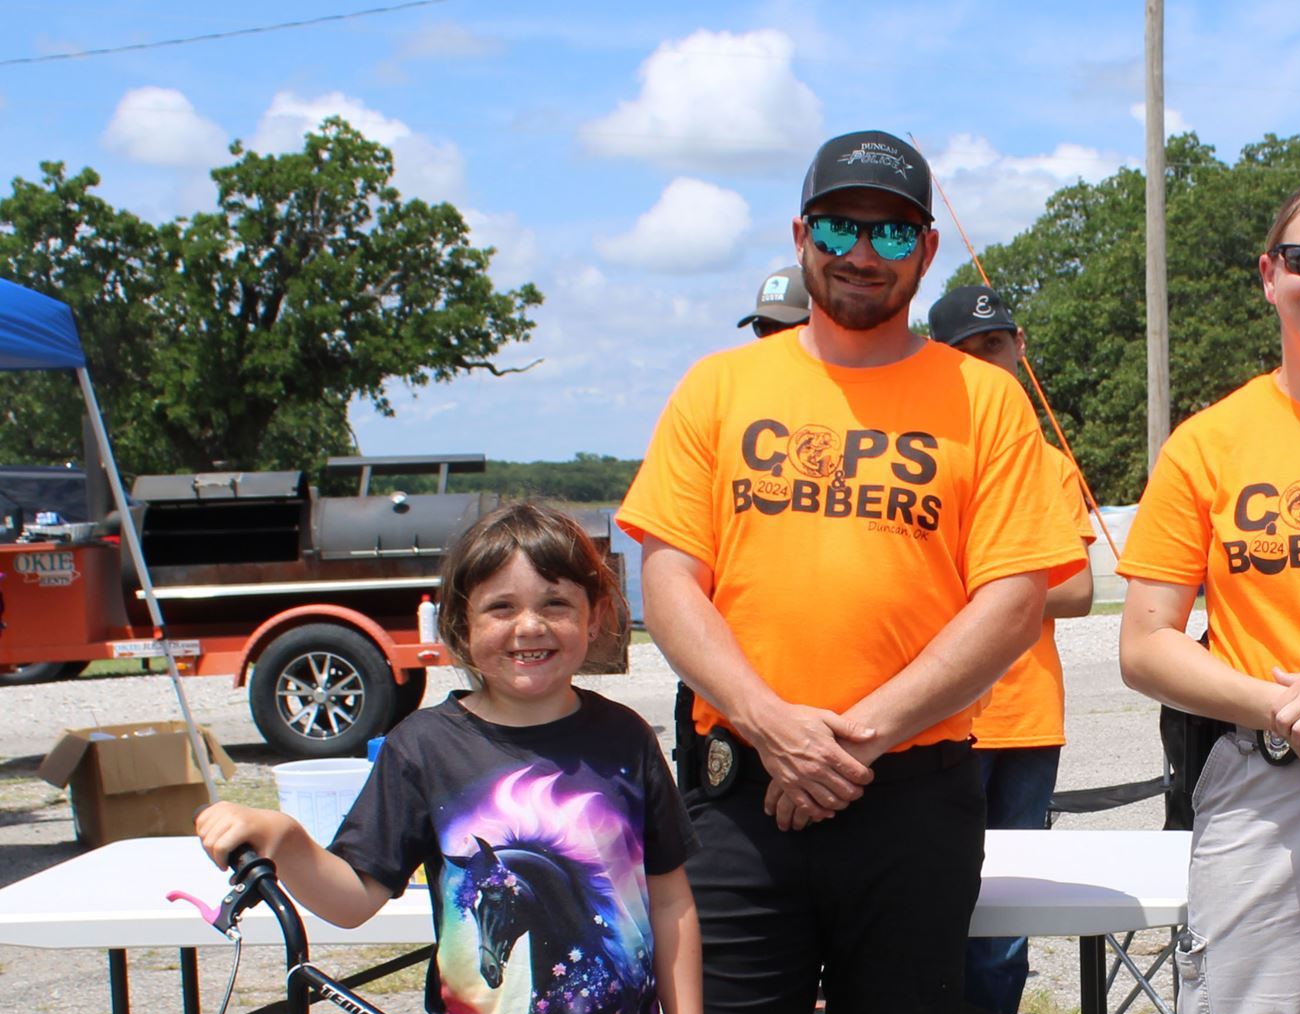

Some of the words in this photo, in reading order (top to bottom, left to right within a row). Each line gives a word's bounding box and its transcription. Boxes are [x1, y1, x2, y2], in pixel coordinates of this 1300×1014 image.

[861, 143, 898, 155] DUNCAN
[742, 419, 938, 486] COPS
[757, 480, 788, 497] 2024
[831, 470, 845, 490] &
[732, 478, 942, 531] BOBBERS
[913, 530, 929, 542] OK
[1253, 540, 1285, 555] 2024
[14, 552, 73, 573] OKIE
